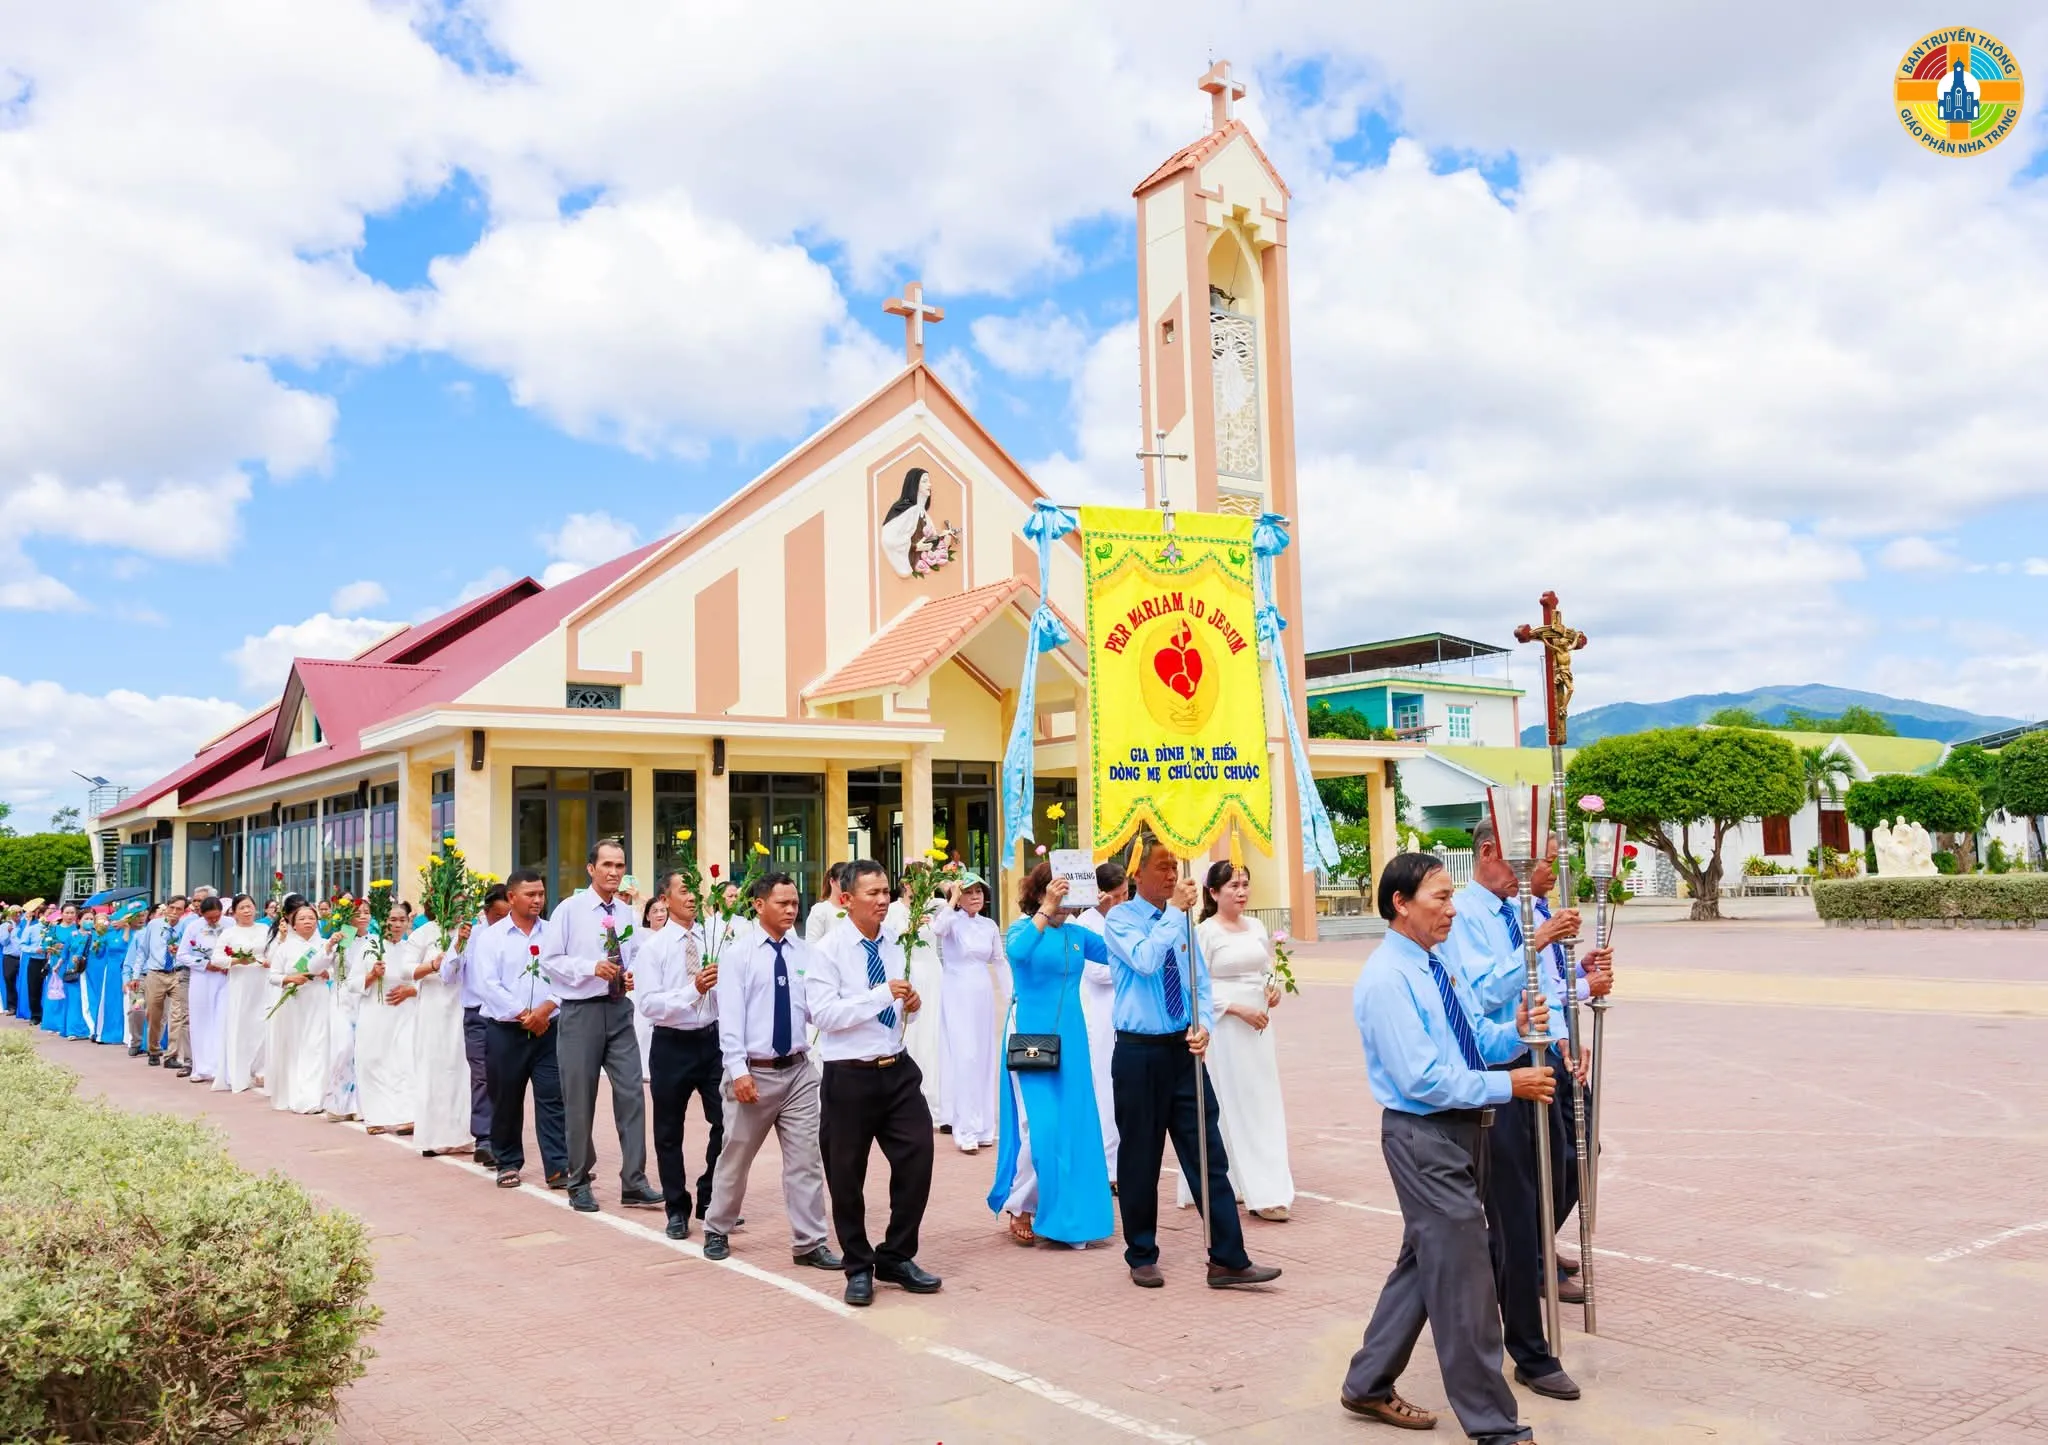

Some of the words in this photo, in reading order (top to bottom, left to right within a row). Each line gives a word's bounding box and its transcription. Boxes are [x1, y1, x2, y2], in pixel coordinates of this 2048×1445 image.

[1104, 623, 1132, 655] PER
[1126, 592, 1184, 631] MARIAM
[1188, 596, 1205, 618] AD
[1207, 607, 1247, 655] JESUM
[1130, 748, 1149, 762] GIA
[1155, 743, 1184, 761] ĐÌNH
[1212, 741, 1237, 761] HIẾN
[1109, 761, 1140, 781] DÒNG
[1147, 766, 1161, 783] MẸ
[1168, 762, 1192, 780] CHÚ
[1193, 761, 1219, 780] CỨU
[1223, 762, 1260, 782] CHUỘC
[1063, 872, 1074, 880] OA
